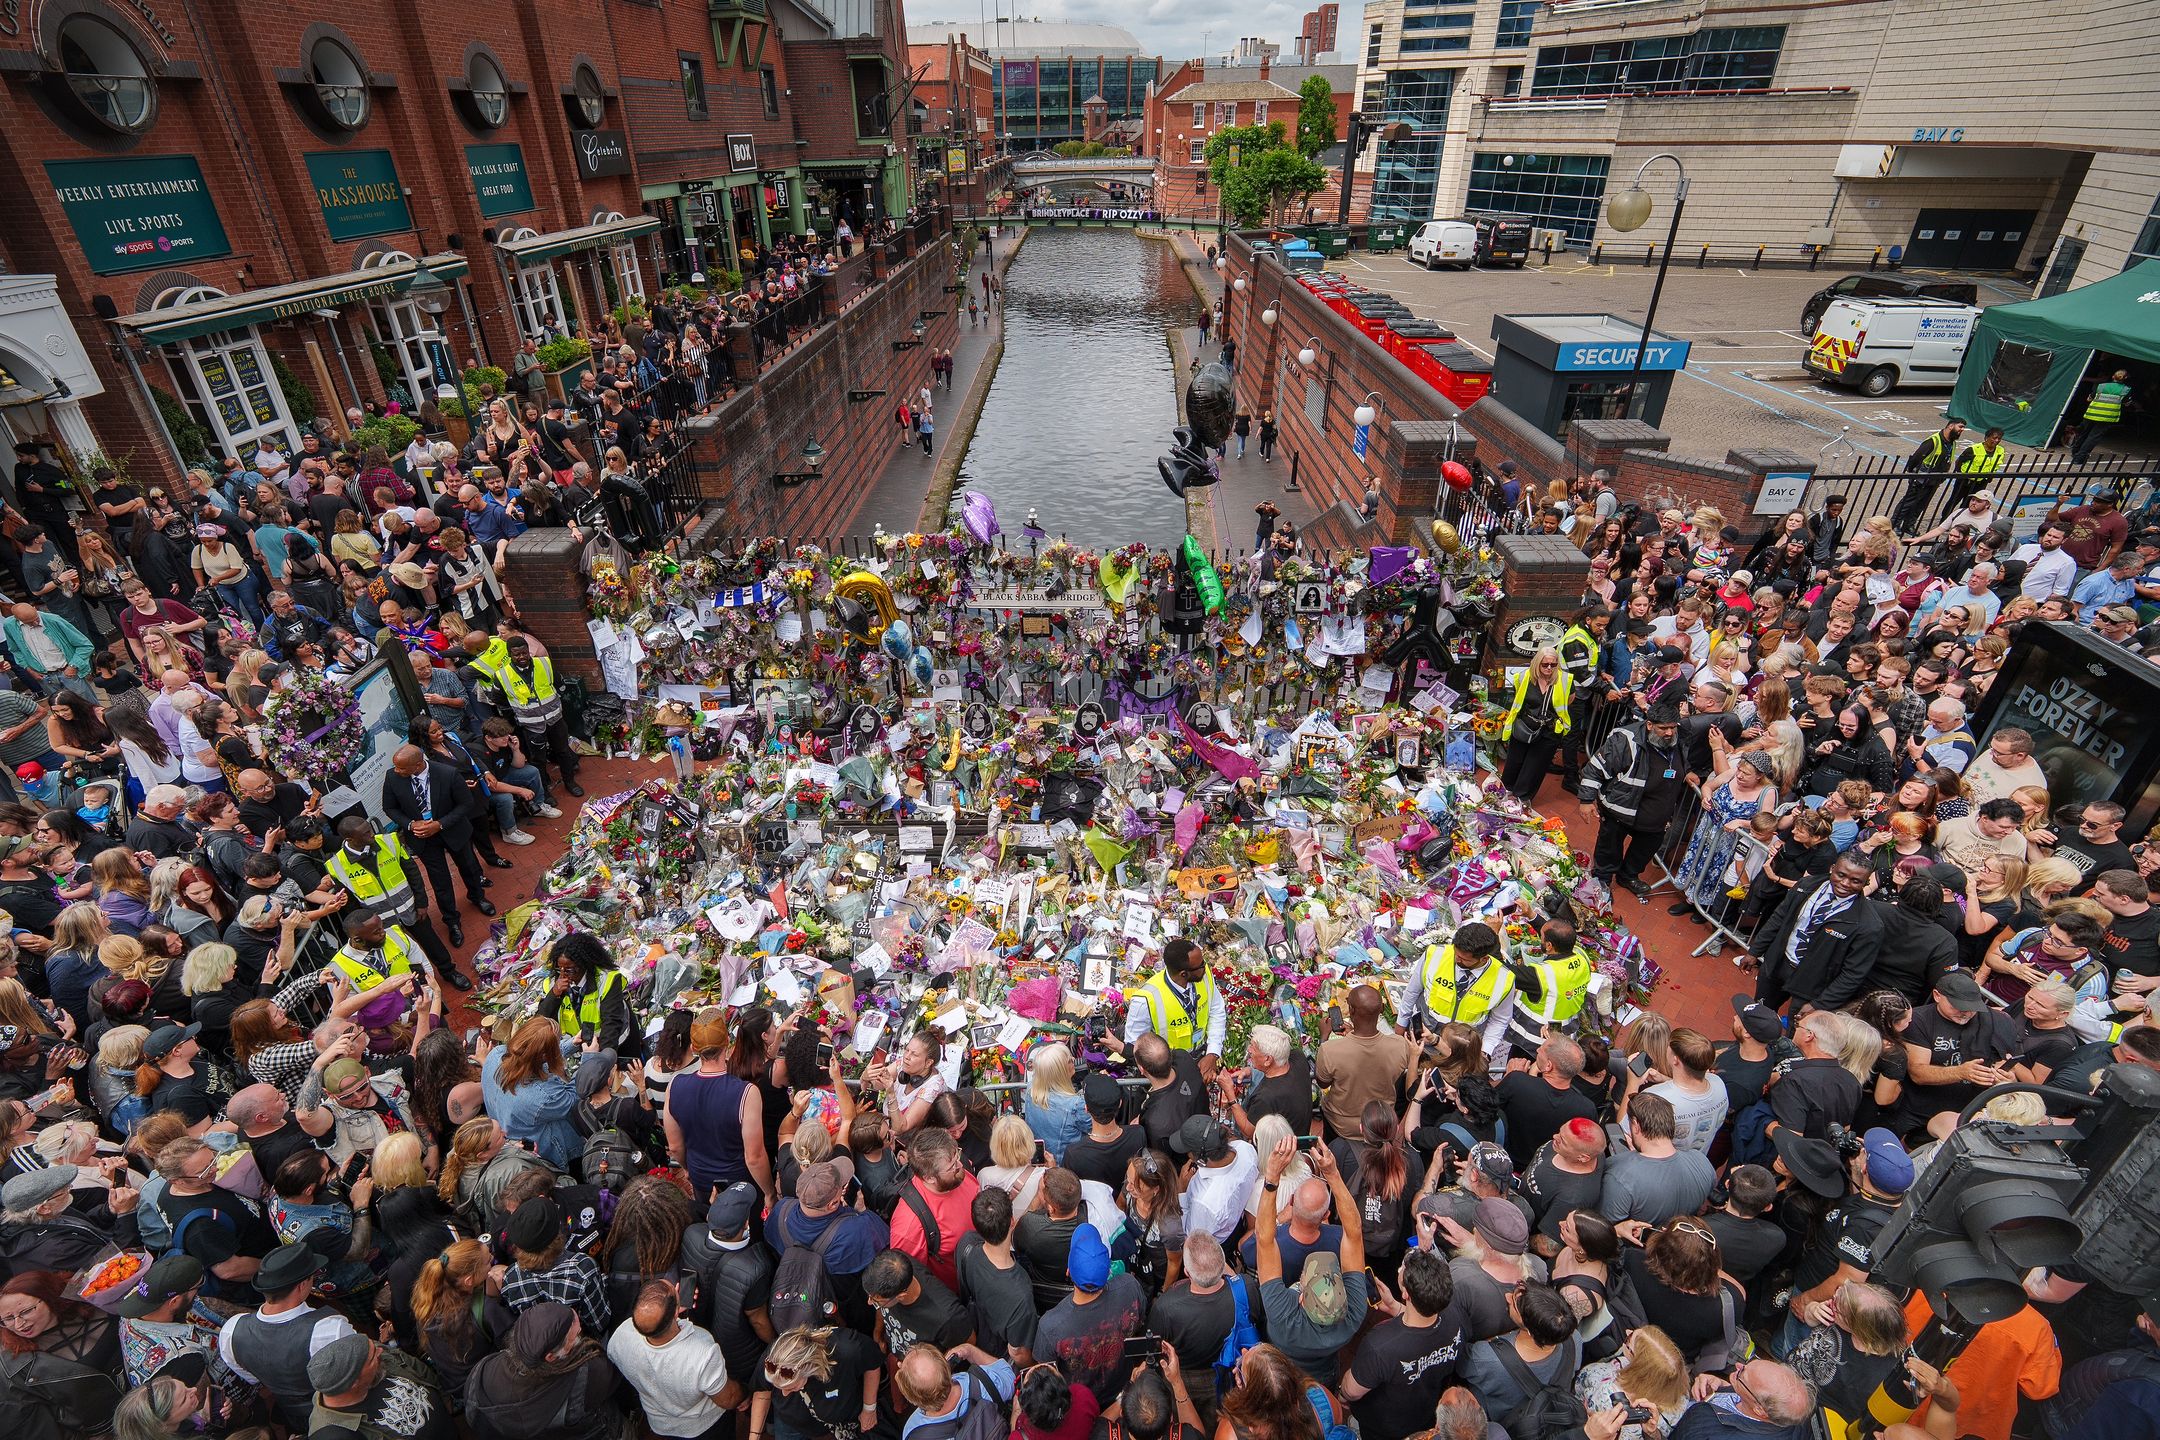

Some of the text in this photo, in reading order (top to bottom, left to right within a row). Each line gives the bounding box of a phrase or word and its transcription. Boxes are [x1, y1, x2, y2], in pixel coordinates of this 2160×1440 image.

[1912, 127, 1966, 143] BAY C
[581, 134, 623, 172] Celebrity
[733, 143, 752, 162] BOX
[341, 168, 358, 179] THE
[482, 165, 498, 175] CASK
[503, 162, 519, 173] CRAFT
[106, 178, 200, 199] ENTERTAINMENT
[482, 184, 514, 197] GREAT FOOD
[777, 183, 786, 205] BOX
[704, 196, 716, 222] BOX
[1032, 208, 1145, 220] BRINDLEYPLACE RIP OZZY
[104, 213, 183, 235] LIVE SPORTS
[114, 241, 154, 255] sky sports
[170, 237, 195, 248] SPORTS
[569, 238, 600, 252] TRADITIONAL
[612, 232, 626, 241] HOUSE
[272, 282, 396, 319] TRADITIONAL FREE HOUSE
[1573, 348, 1673, 365] SECURTY
[211, 374, 223, 382] PUB
[437, 367, 446, 381] OUT
[1768, 488, 1797, 496] BAY C
[983, 593, 1013, 601] BLACK
[1060, 593, 1096, 601] BRIDGE
[1514, 616, 1550, 630] CANALSIDE
[512, 679, 524, 688] 311
[1428, 682, 1458, 706] RIP
[2049, 676, 2118, 728] OZZY
[2014, 684, 2126, 770] FOREVER
[352, 769, 368, 784] Canals
[1359, 824, 1395, 839] Birmingham
[348, 868, 367, 879] 442
[866, 870, 895, 883] BLACK
[869, 866, 885, 912] SABBATH
[354, 968, 374, 985] 454
[1435, 976, 1455, 991] 492
[1474, 991, 1491, 1001] snsg
[1170, 1016, 1189, 1027] 433
[1418, 1344, 1455, 1363] BLACK
[1408, 1350, 1459, 1385] SABBATH
